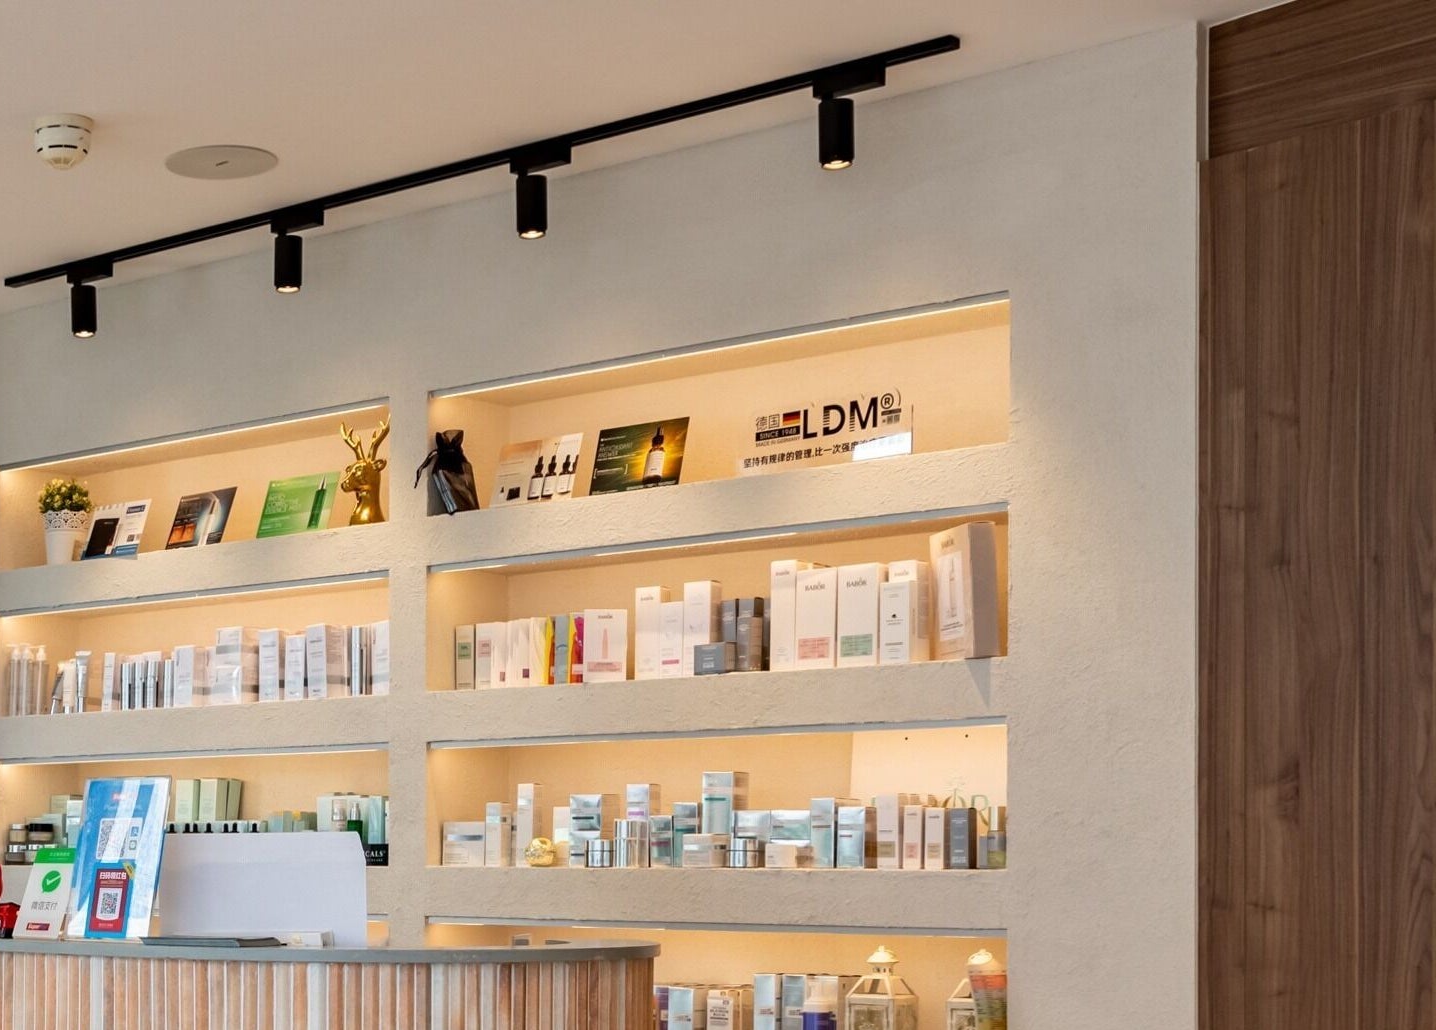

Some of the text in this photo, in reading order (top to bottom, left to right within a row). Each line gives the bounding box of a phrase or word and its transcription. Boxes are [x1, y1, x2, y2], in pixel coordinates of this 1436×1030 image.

[755, 414, 780, 431] 德国
[759, 428, 797, 440] SINCE 1948
